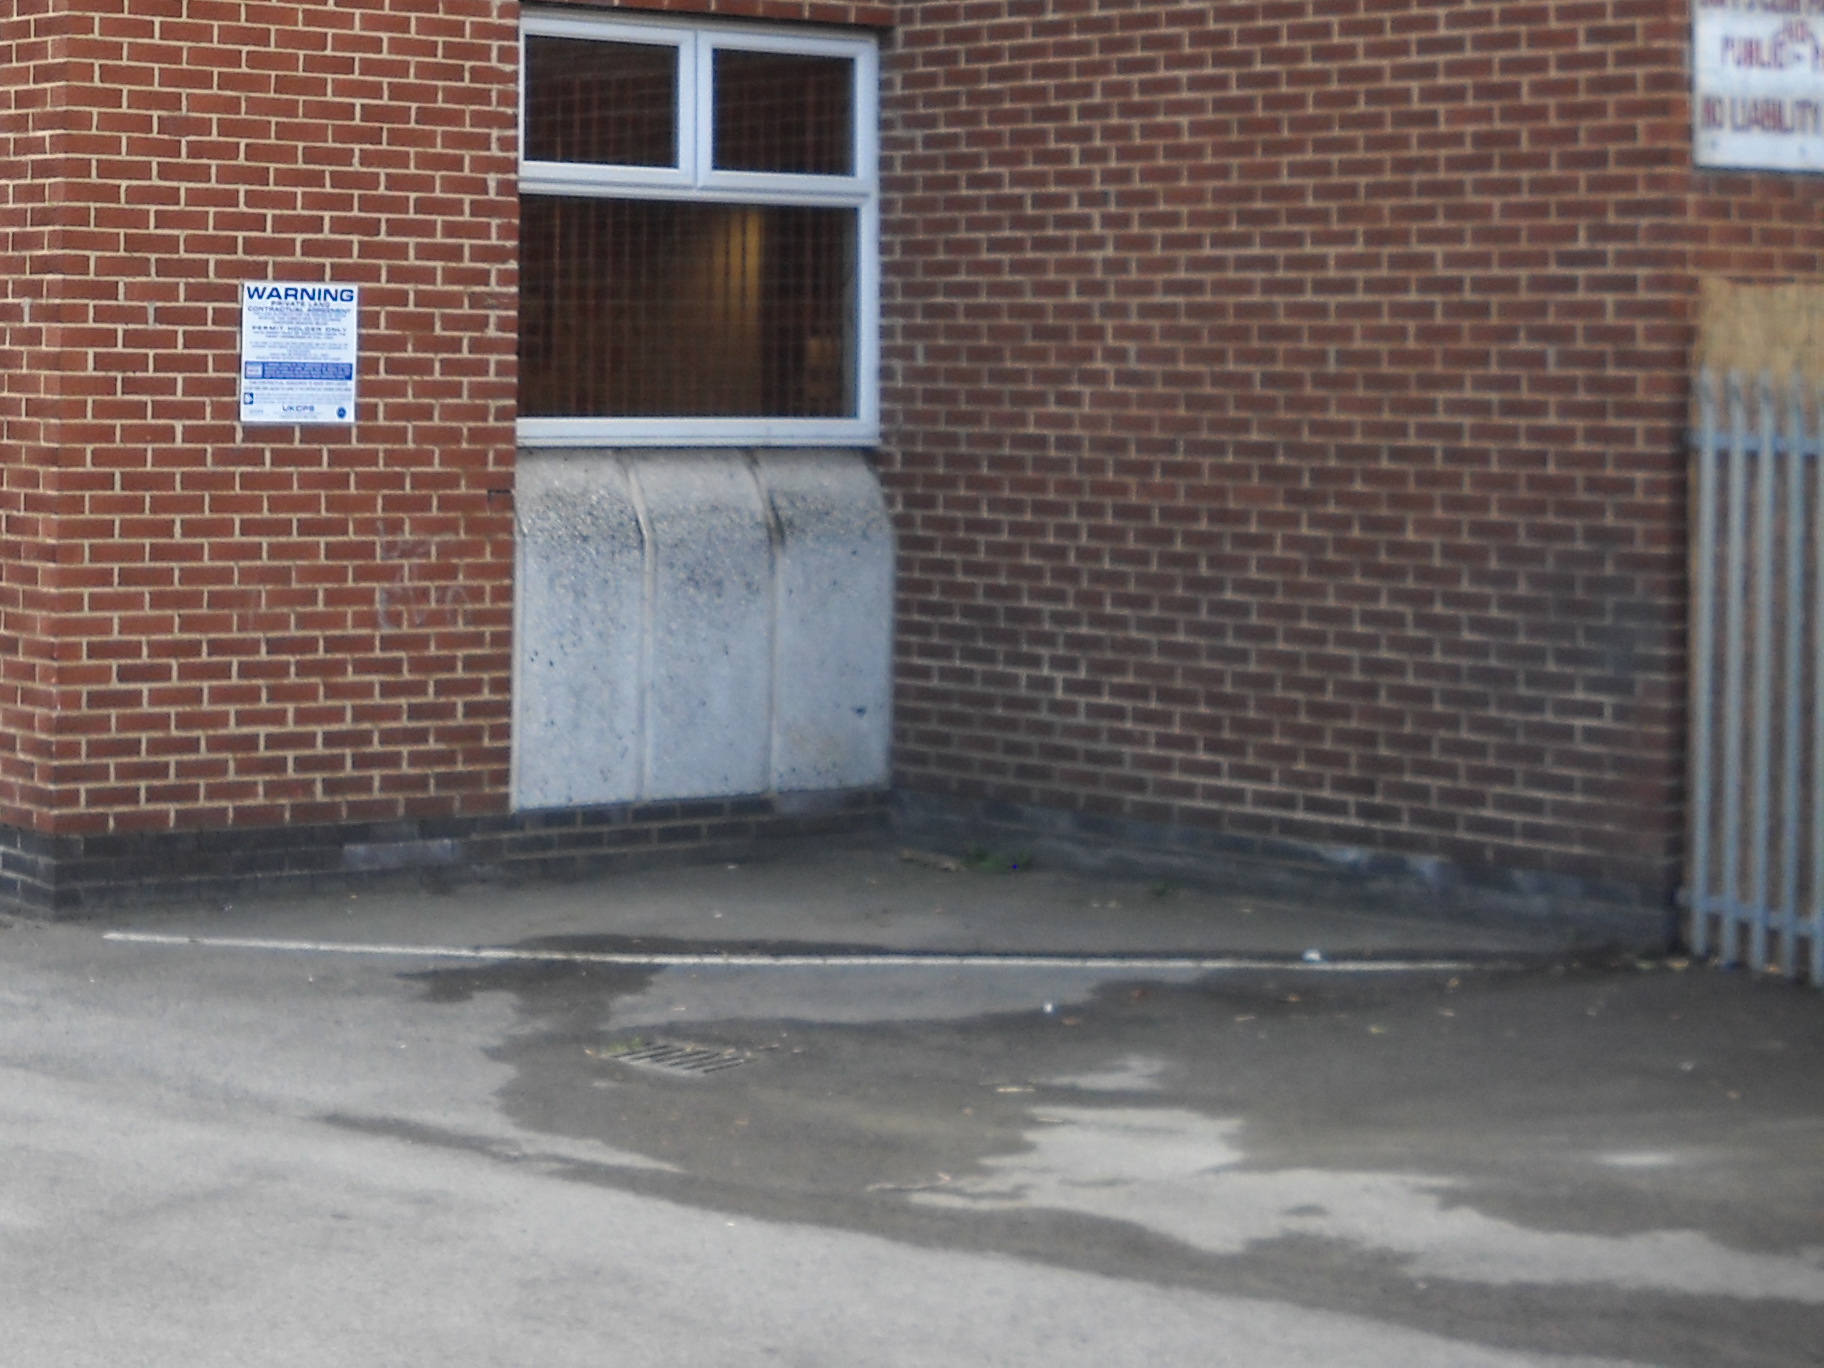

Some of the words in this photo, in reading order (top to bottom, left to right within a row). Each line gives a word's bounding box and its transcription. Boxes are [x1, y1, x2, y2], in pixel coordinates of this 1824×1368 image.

[1702, 95, 1725, 130] NO
[1730, 95, 1824, 137] LIABILITY
[246, 285, 354, 302] WARNING
